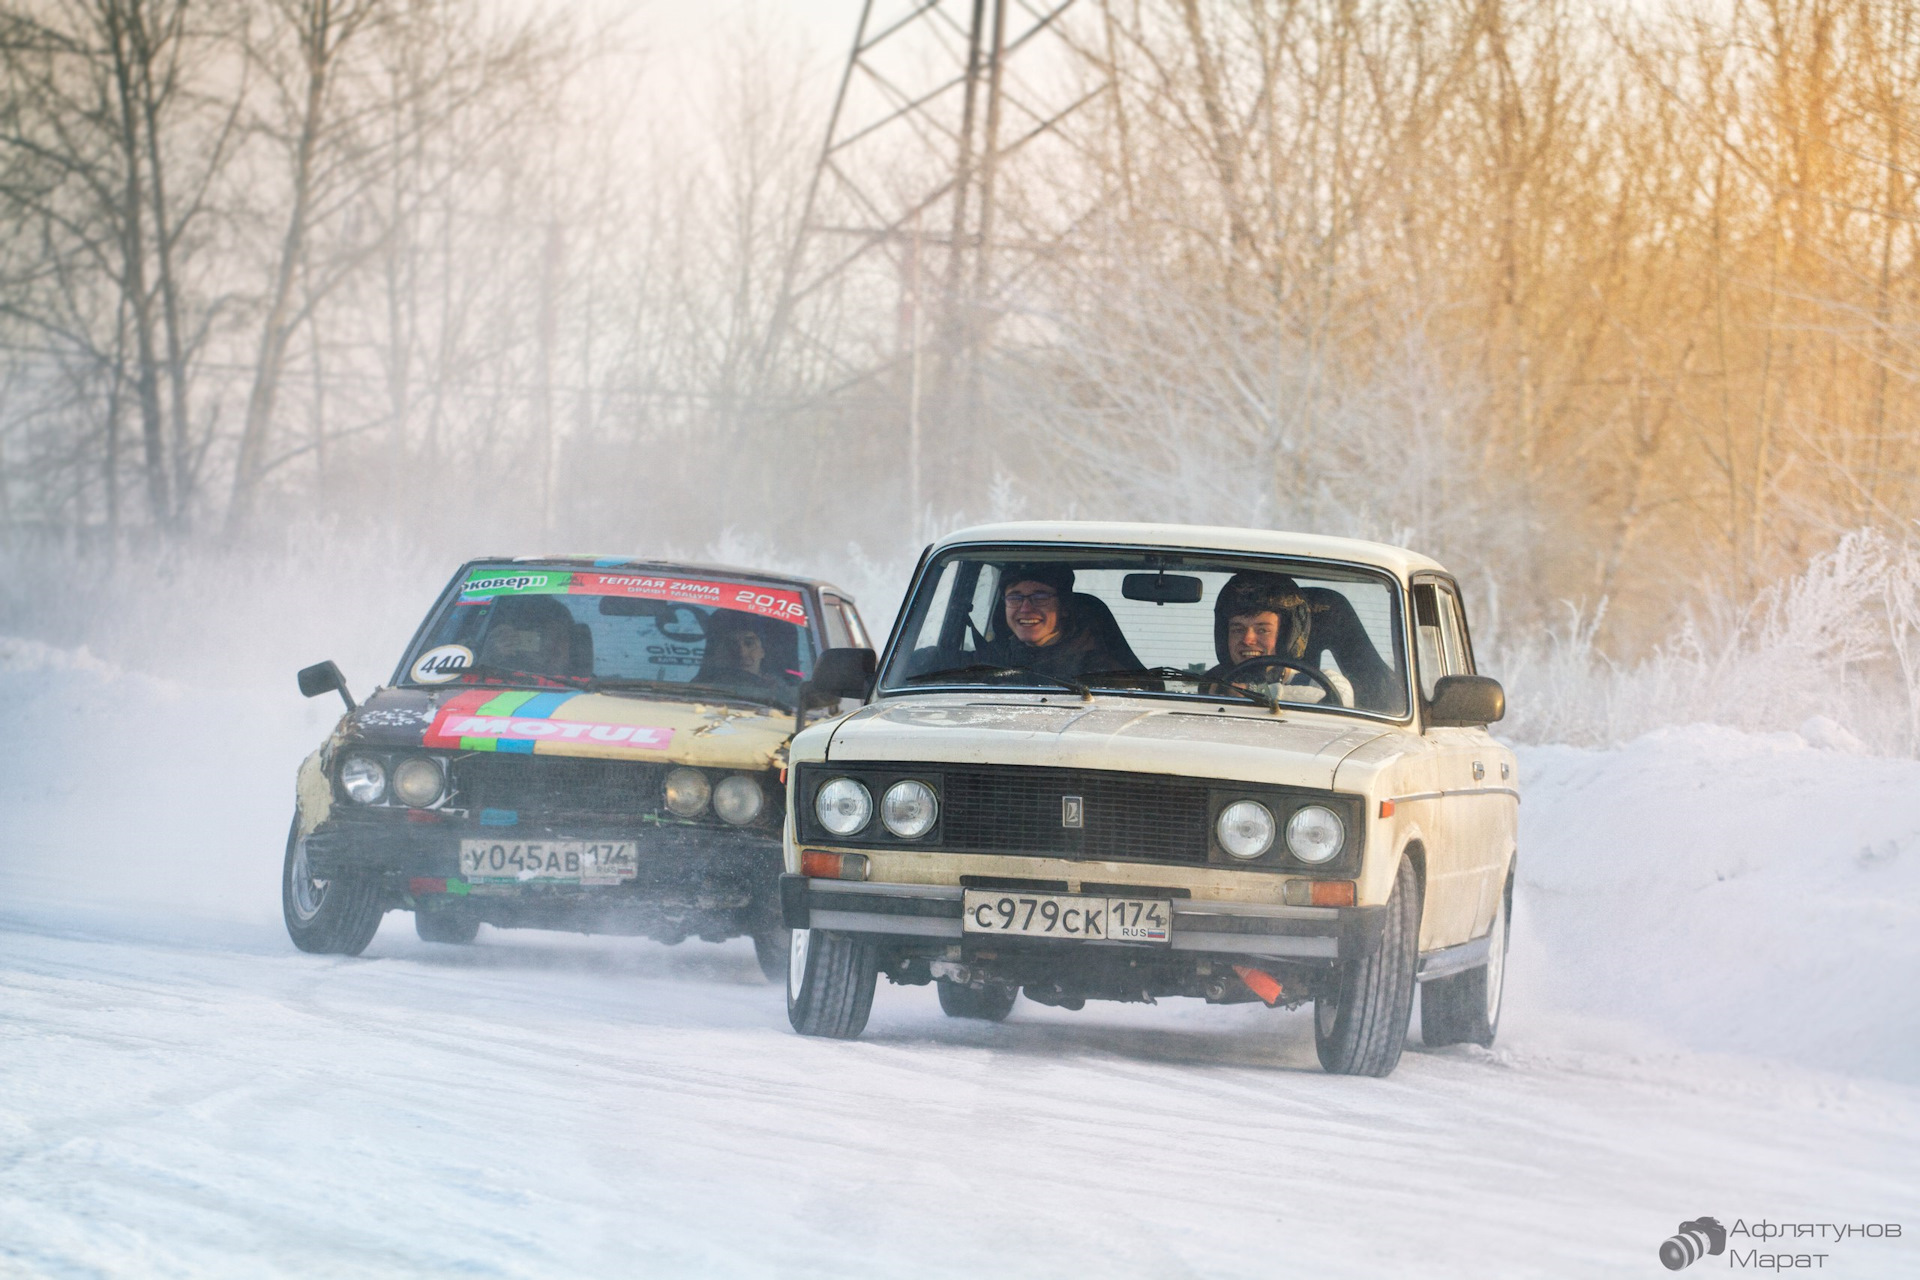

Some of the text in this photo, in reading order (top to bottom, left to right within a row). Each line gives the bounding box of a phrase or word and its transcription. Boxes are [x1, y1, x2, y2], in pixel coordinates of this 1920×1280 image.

[599, 576, 666, 588] ТЕПЛАЯ
[735, 590, 805, 616] 2016
[758, 607, 790, 619] ЭТАП
[420, 655, 466, 673] 440
[452, 716, 661, 743] MOTUL
[588, 845, 628, 865] 174
[1112, 902, 1162, 928] 174
[1122, 927, 1147, 938] RUS
